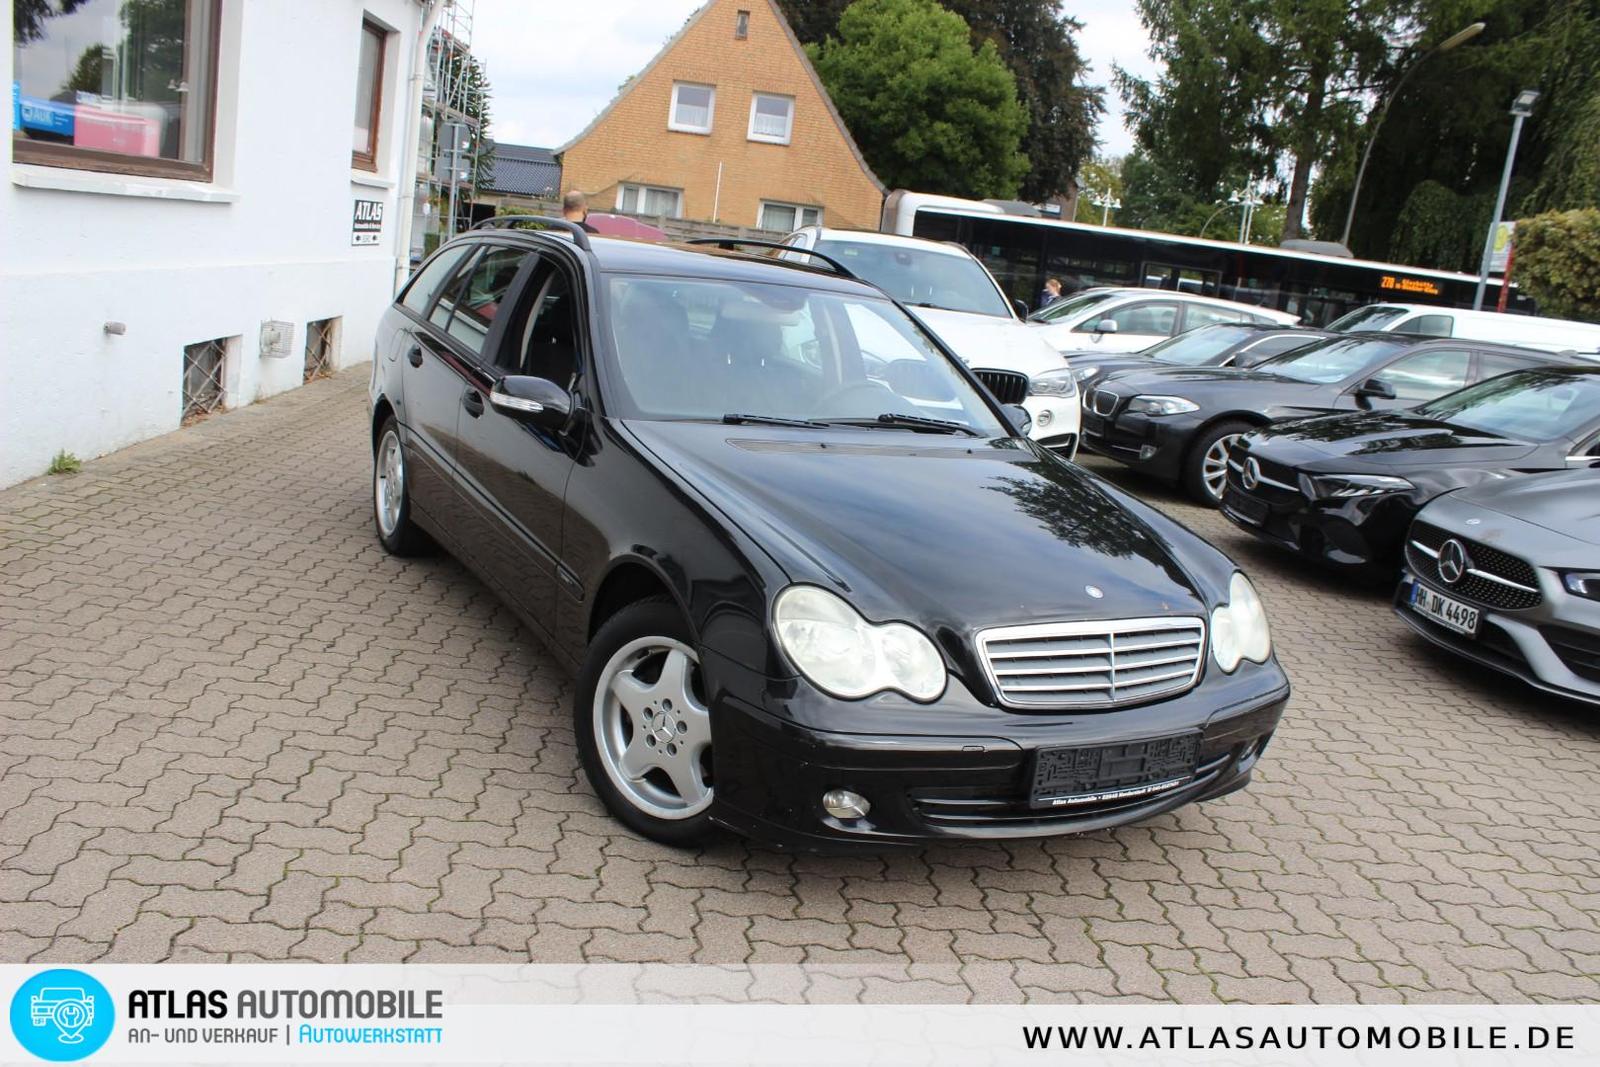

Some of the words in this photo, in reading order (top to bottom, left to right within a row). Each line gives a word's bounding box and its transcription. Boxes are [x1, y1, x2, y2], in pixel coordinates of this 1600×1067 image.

[355, 201, 383, 221] ATLAS
[1417, 586, 1428, 607] HH
[1431, 594, 1446, 617] DK
[1446, 602, 1477, 630] 4498
[1052, 798, 1067, 806] Atlas
[1067, 796, 1098, 804] Automobile
